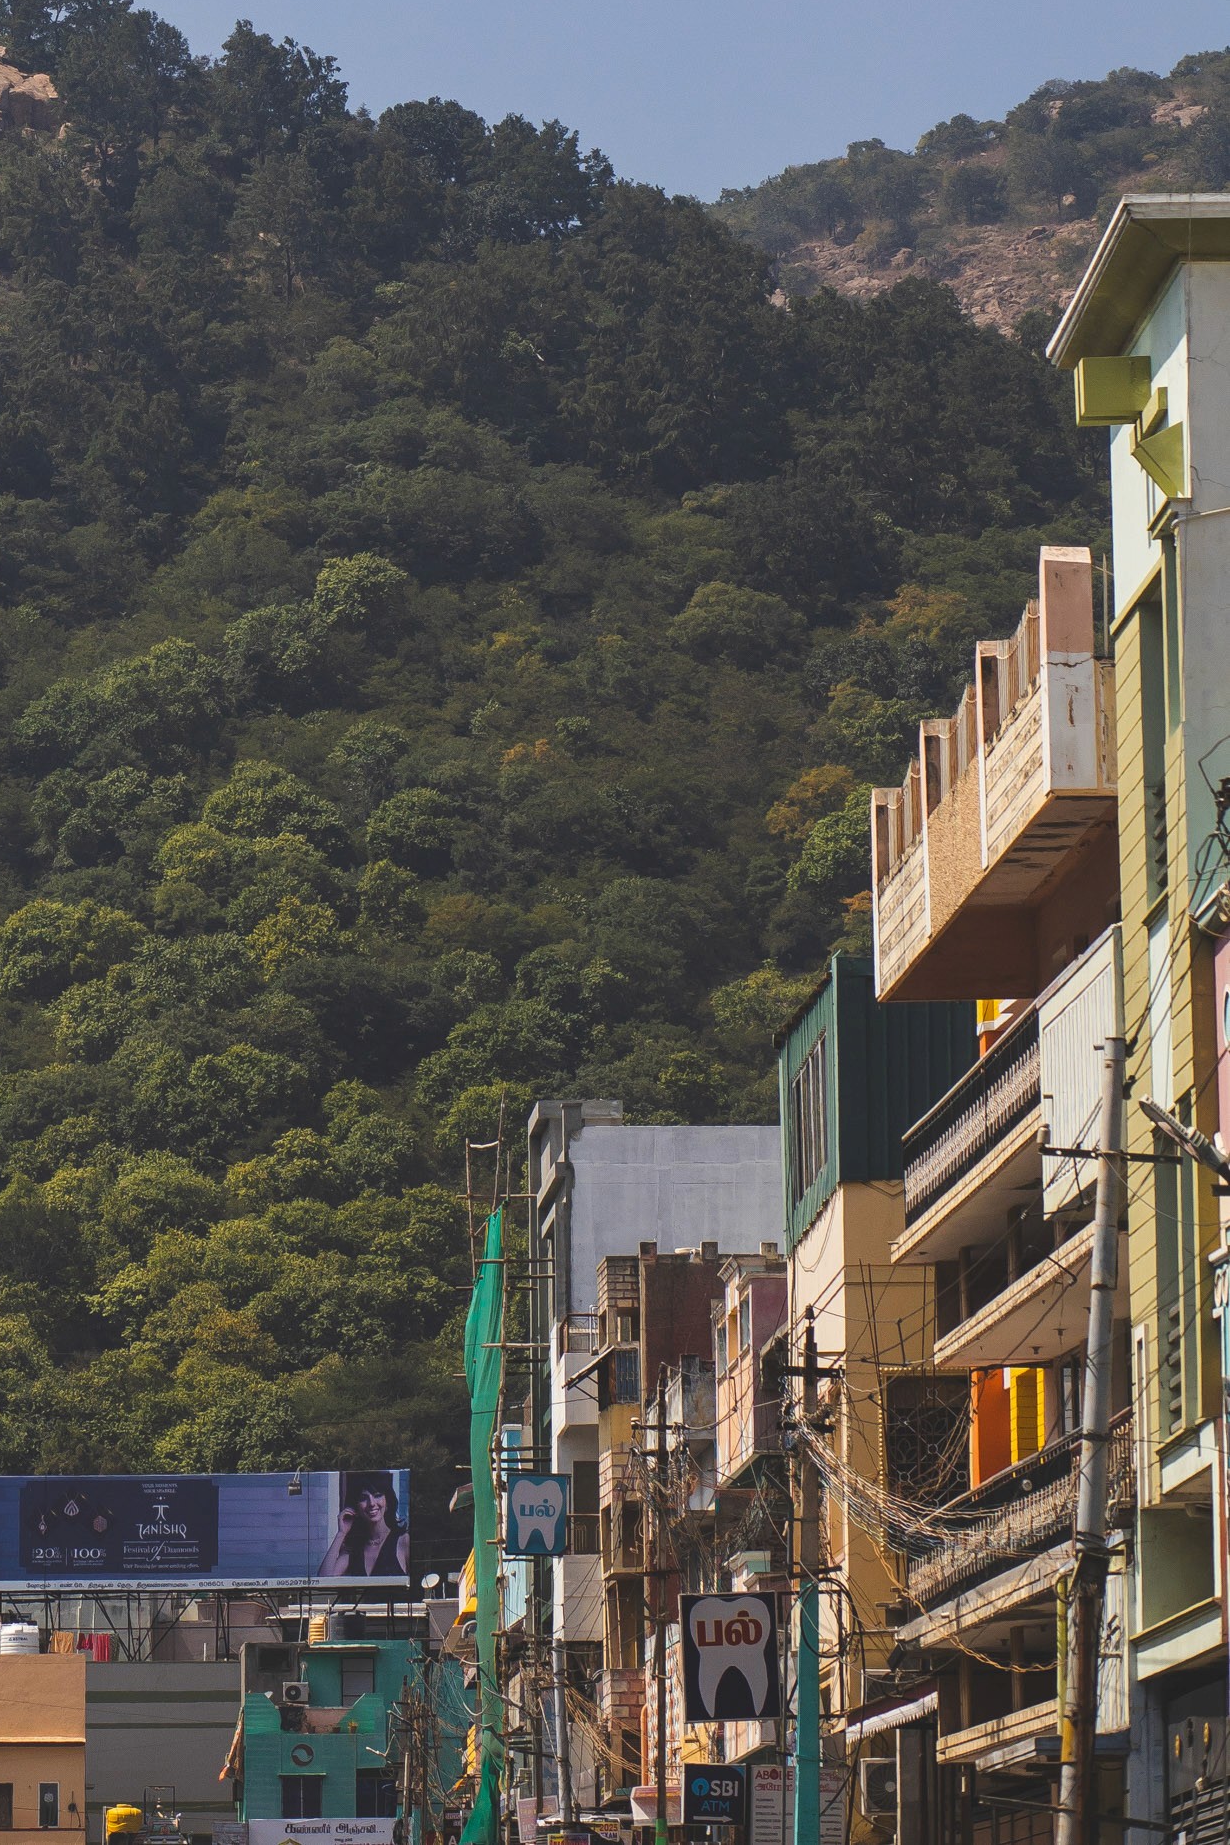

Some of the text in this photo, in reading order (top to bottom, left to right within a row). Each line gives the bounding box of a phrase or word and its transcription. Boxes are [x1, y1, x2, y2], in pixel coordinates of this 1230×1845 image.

[519, 1498, 556, 1518] பல்
[123, 1540, 200, 1562] Festival of Diamonds
[696, 1610, 763, 1647] பல்
[755, 1768, 794, 1781] ABOE
[710, 1780, 738, 1797] SBI
[701, 1800, 730, 1812] ATM
[284, 1823, 332, 1835] கண்ணீர்
[599, 1824, 618, 1832] 2025
